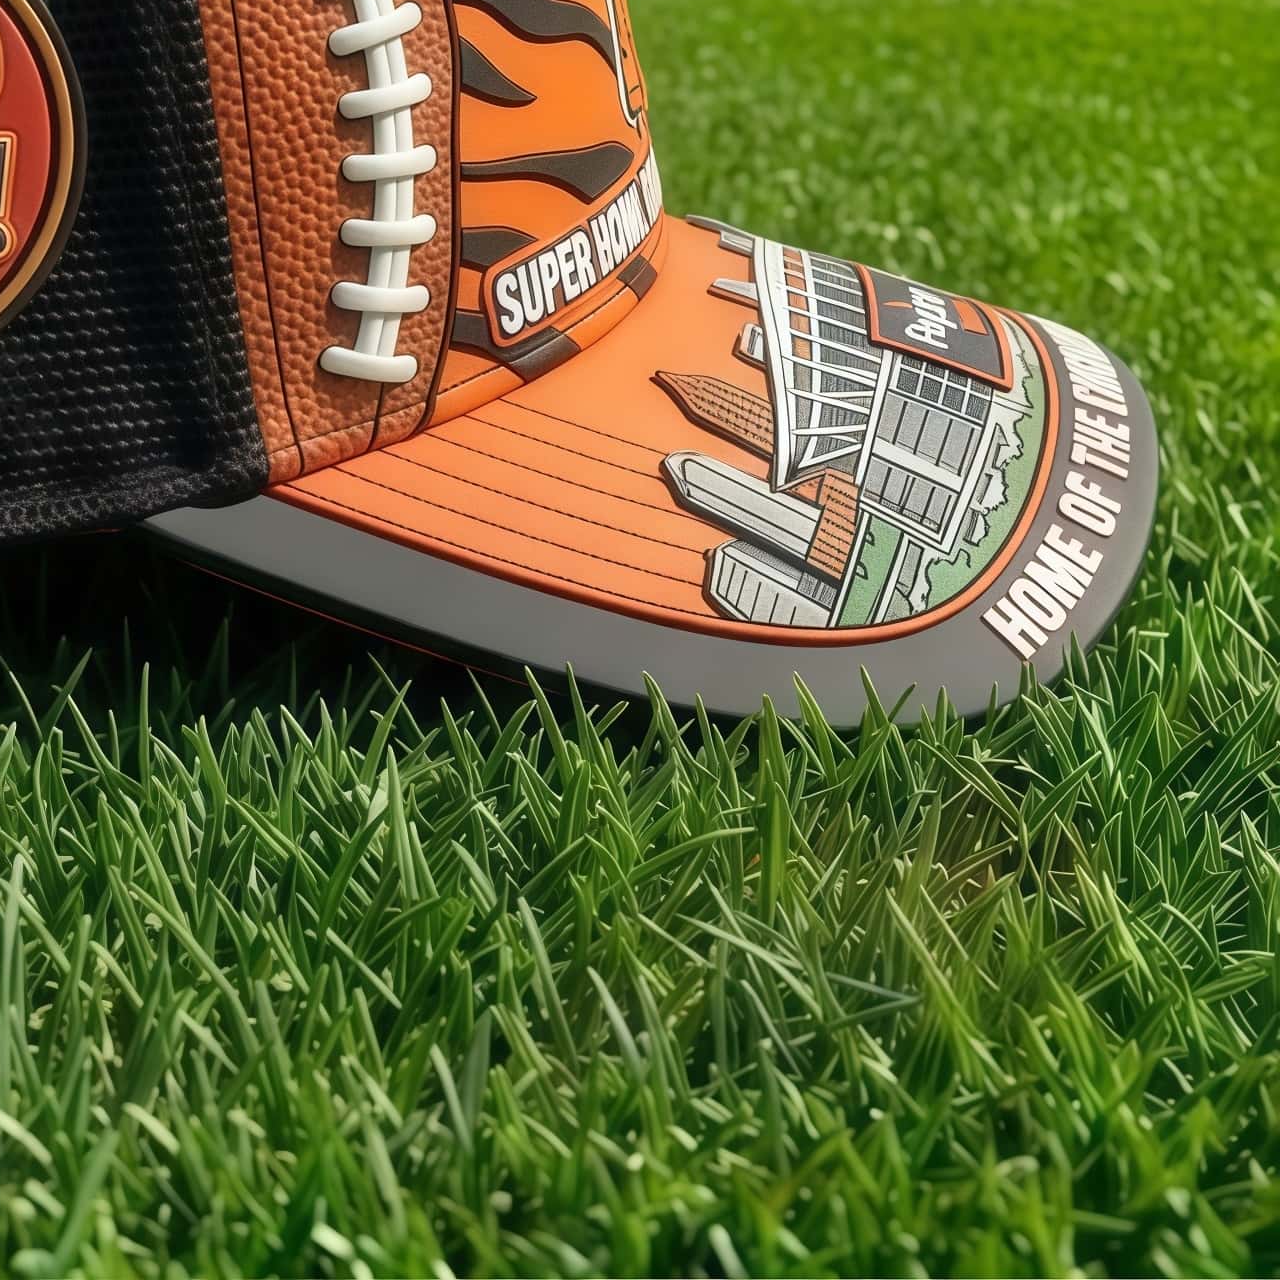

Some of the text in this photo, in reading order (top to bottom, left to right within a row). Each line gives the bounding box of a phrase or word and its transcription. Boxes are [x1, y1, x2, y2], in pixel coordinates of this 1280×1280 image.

[496, 229, 597, 335] SUPER
[1068, 406, 1131, 479] THE
[1059, 472, 1123, 538] OF
[982, 524, 1104, 660] HOME
